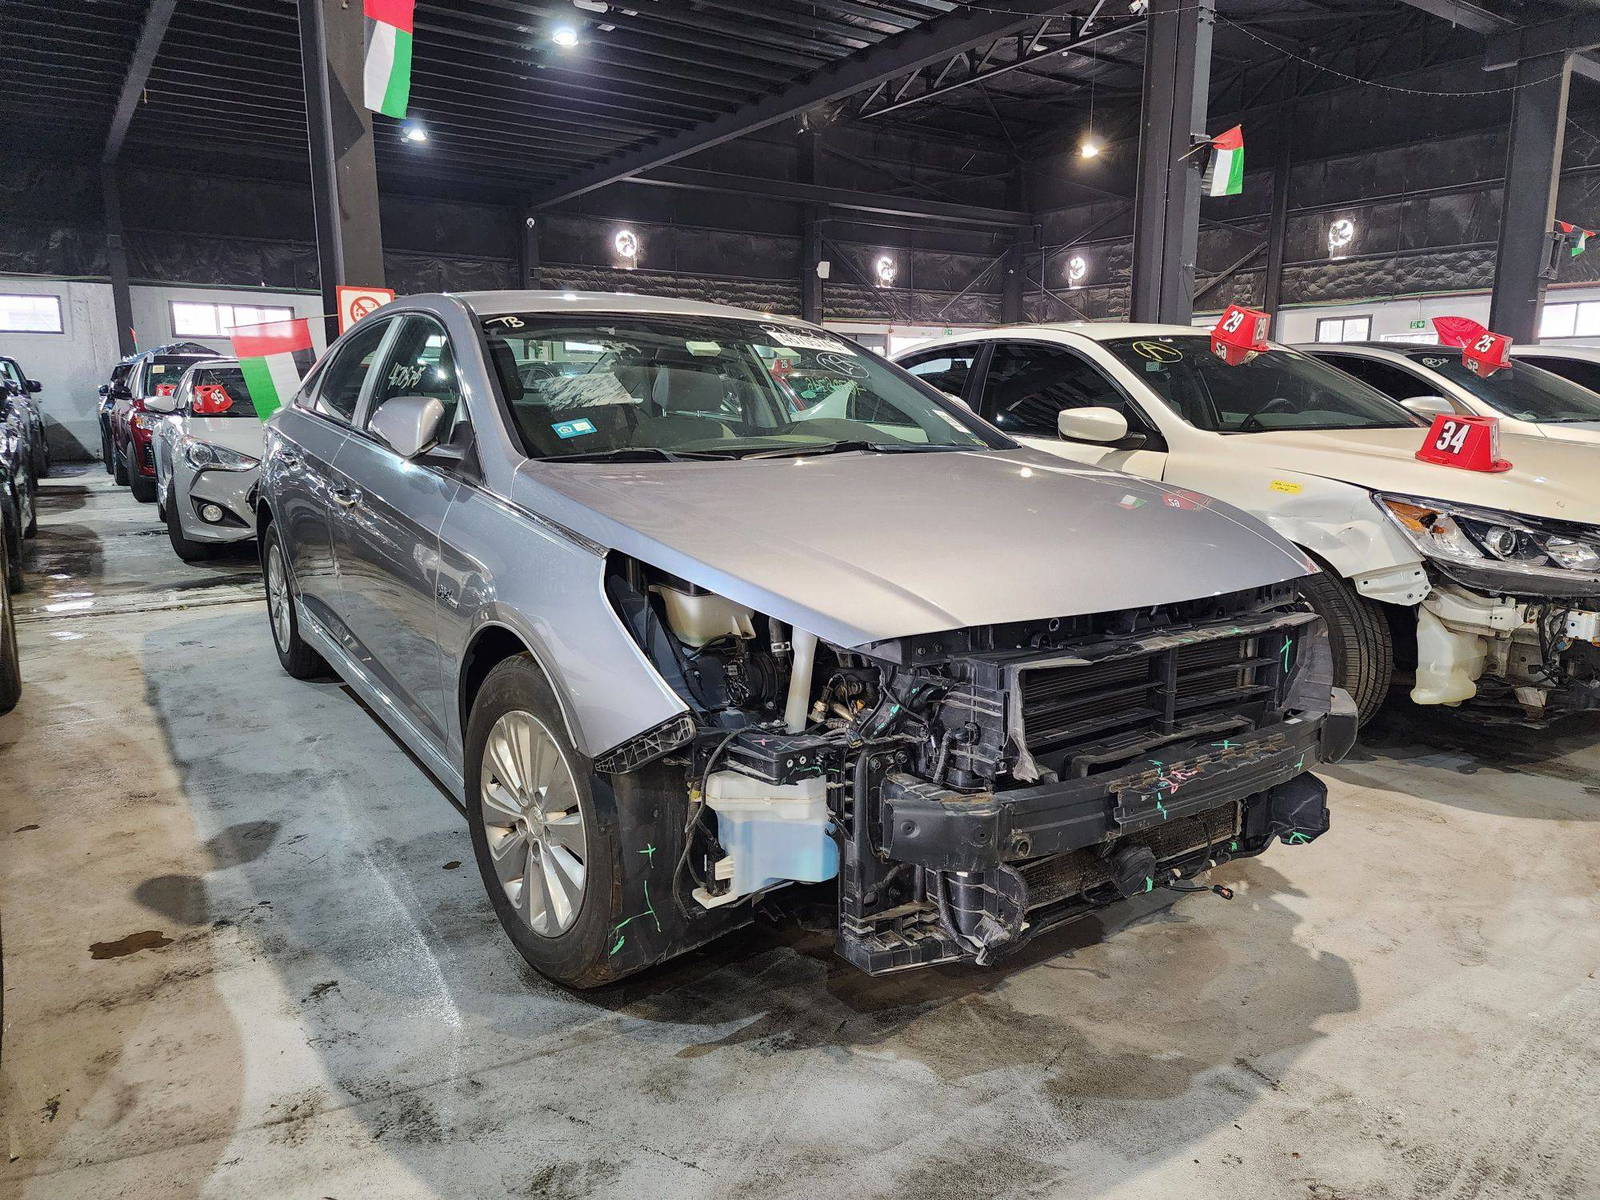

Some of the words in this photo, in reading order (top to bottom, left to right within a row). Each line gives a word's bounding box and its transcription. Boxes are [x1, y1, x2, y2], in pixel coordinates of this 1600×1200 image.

[1222, 310, 1245, 333] 29
[1474, 334, 1496, 353] 25
[210, 389, 225, 405] 35
[1436, 421, 1471, 454] 34
